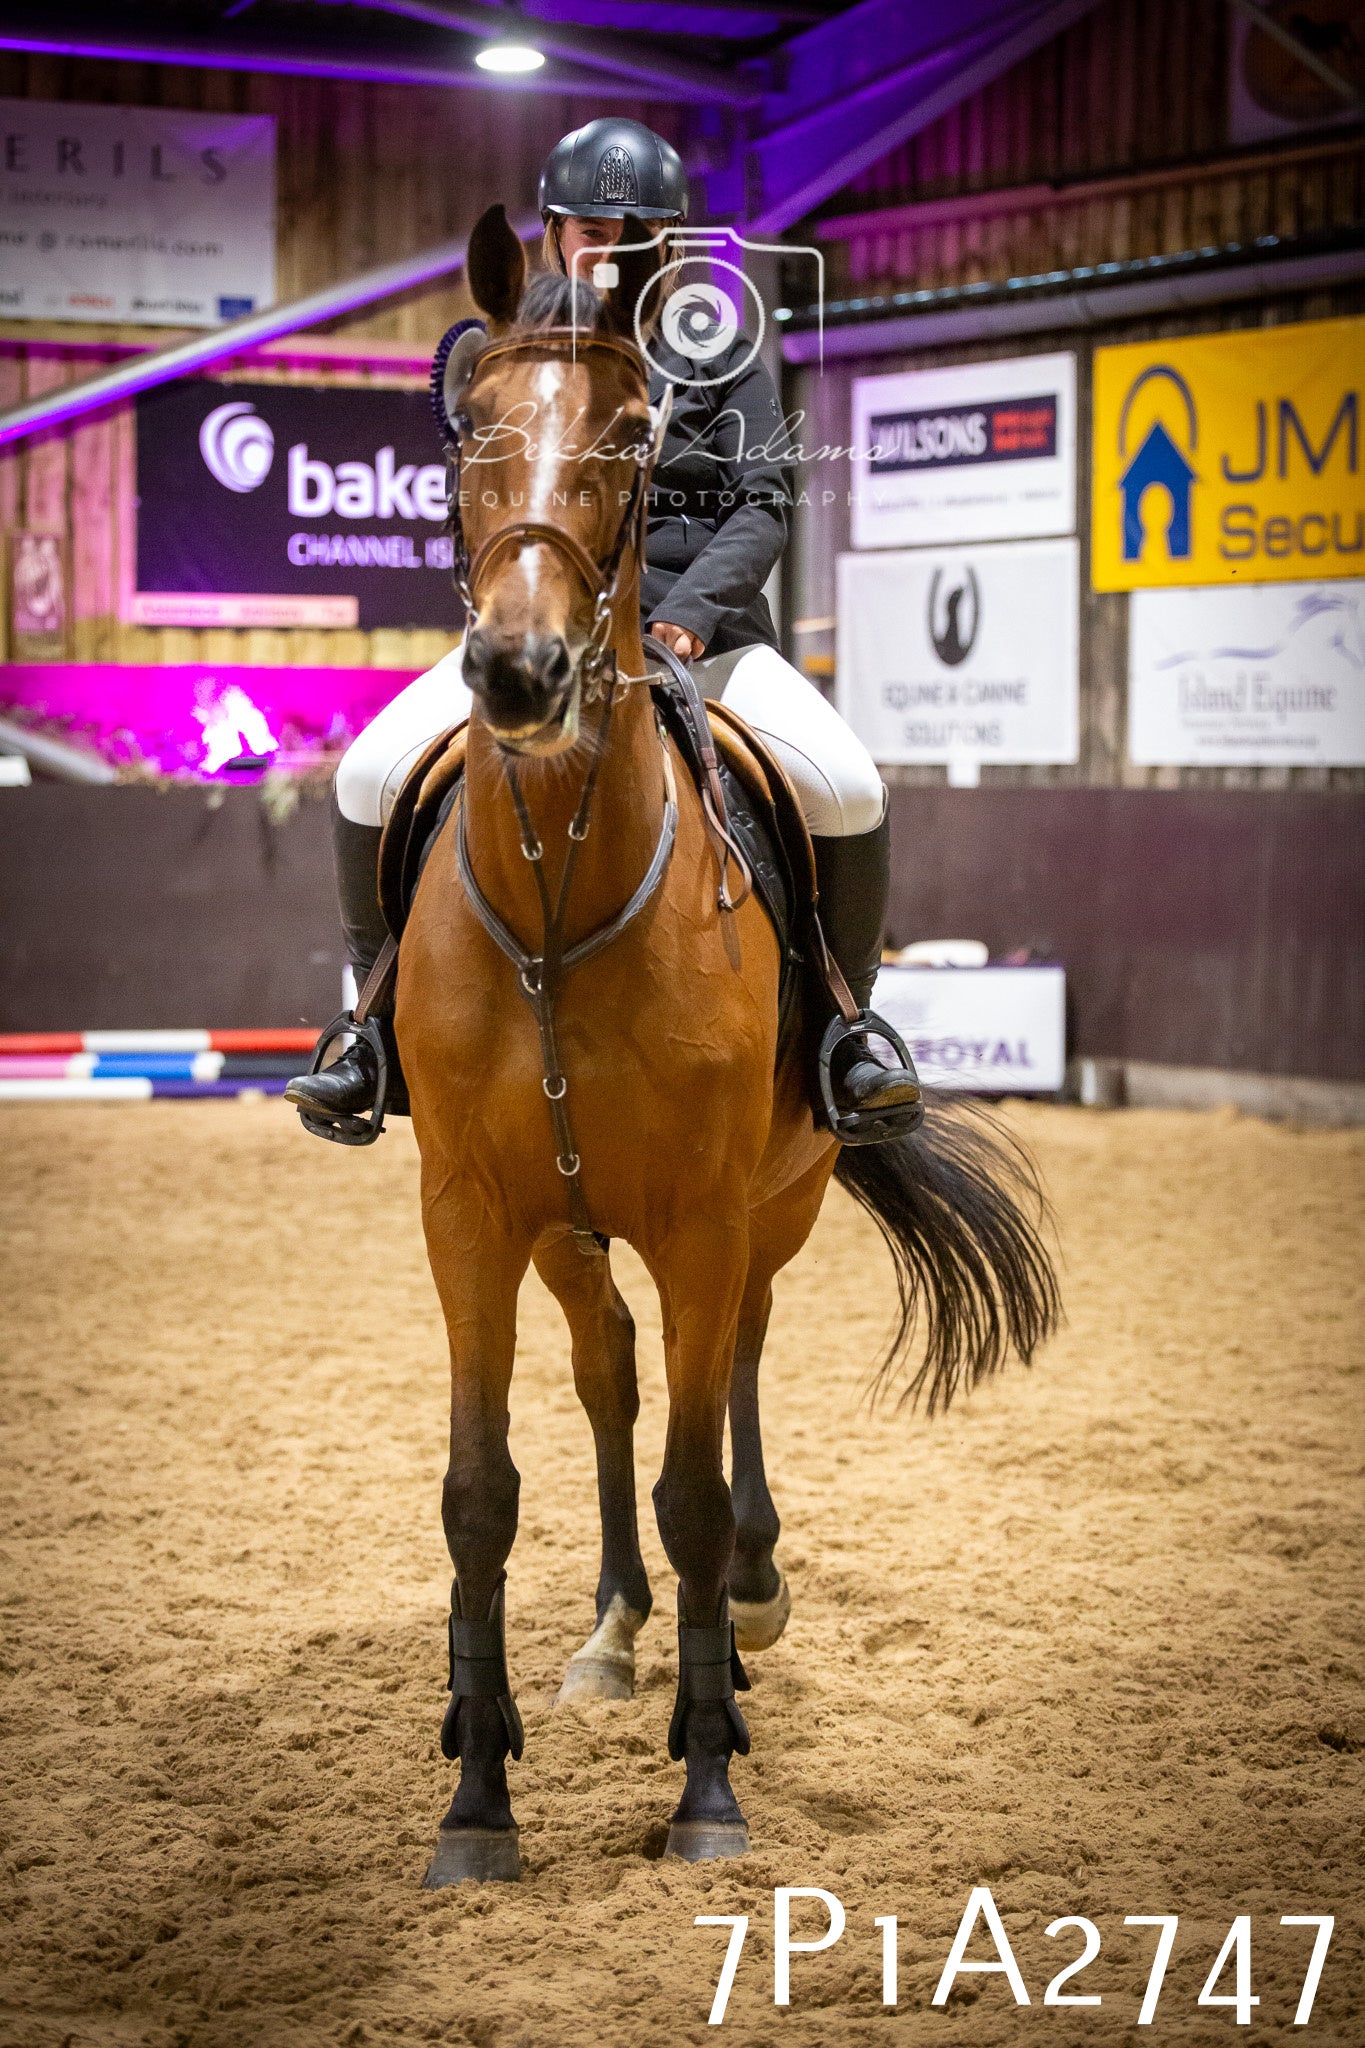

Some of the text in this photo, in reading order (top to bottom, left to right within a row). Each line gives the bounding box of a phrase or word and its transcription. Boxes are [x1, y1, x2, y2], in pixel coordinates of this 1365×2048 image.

[1220, 390, 1358, 485] JM
[287, 442, 449, 521] bake
[287, 532, 424, 569] CHANNEL
[1219, 503, 1364, 561] Secu
